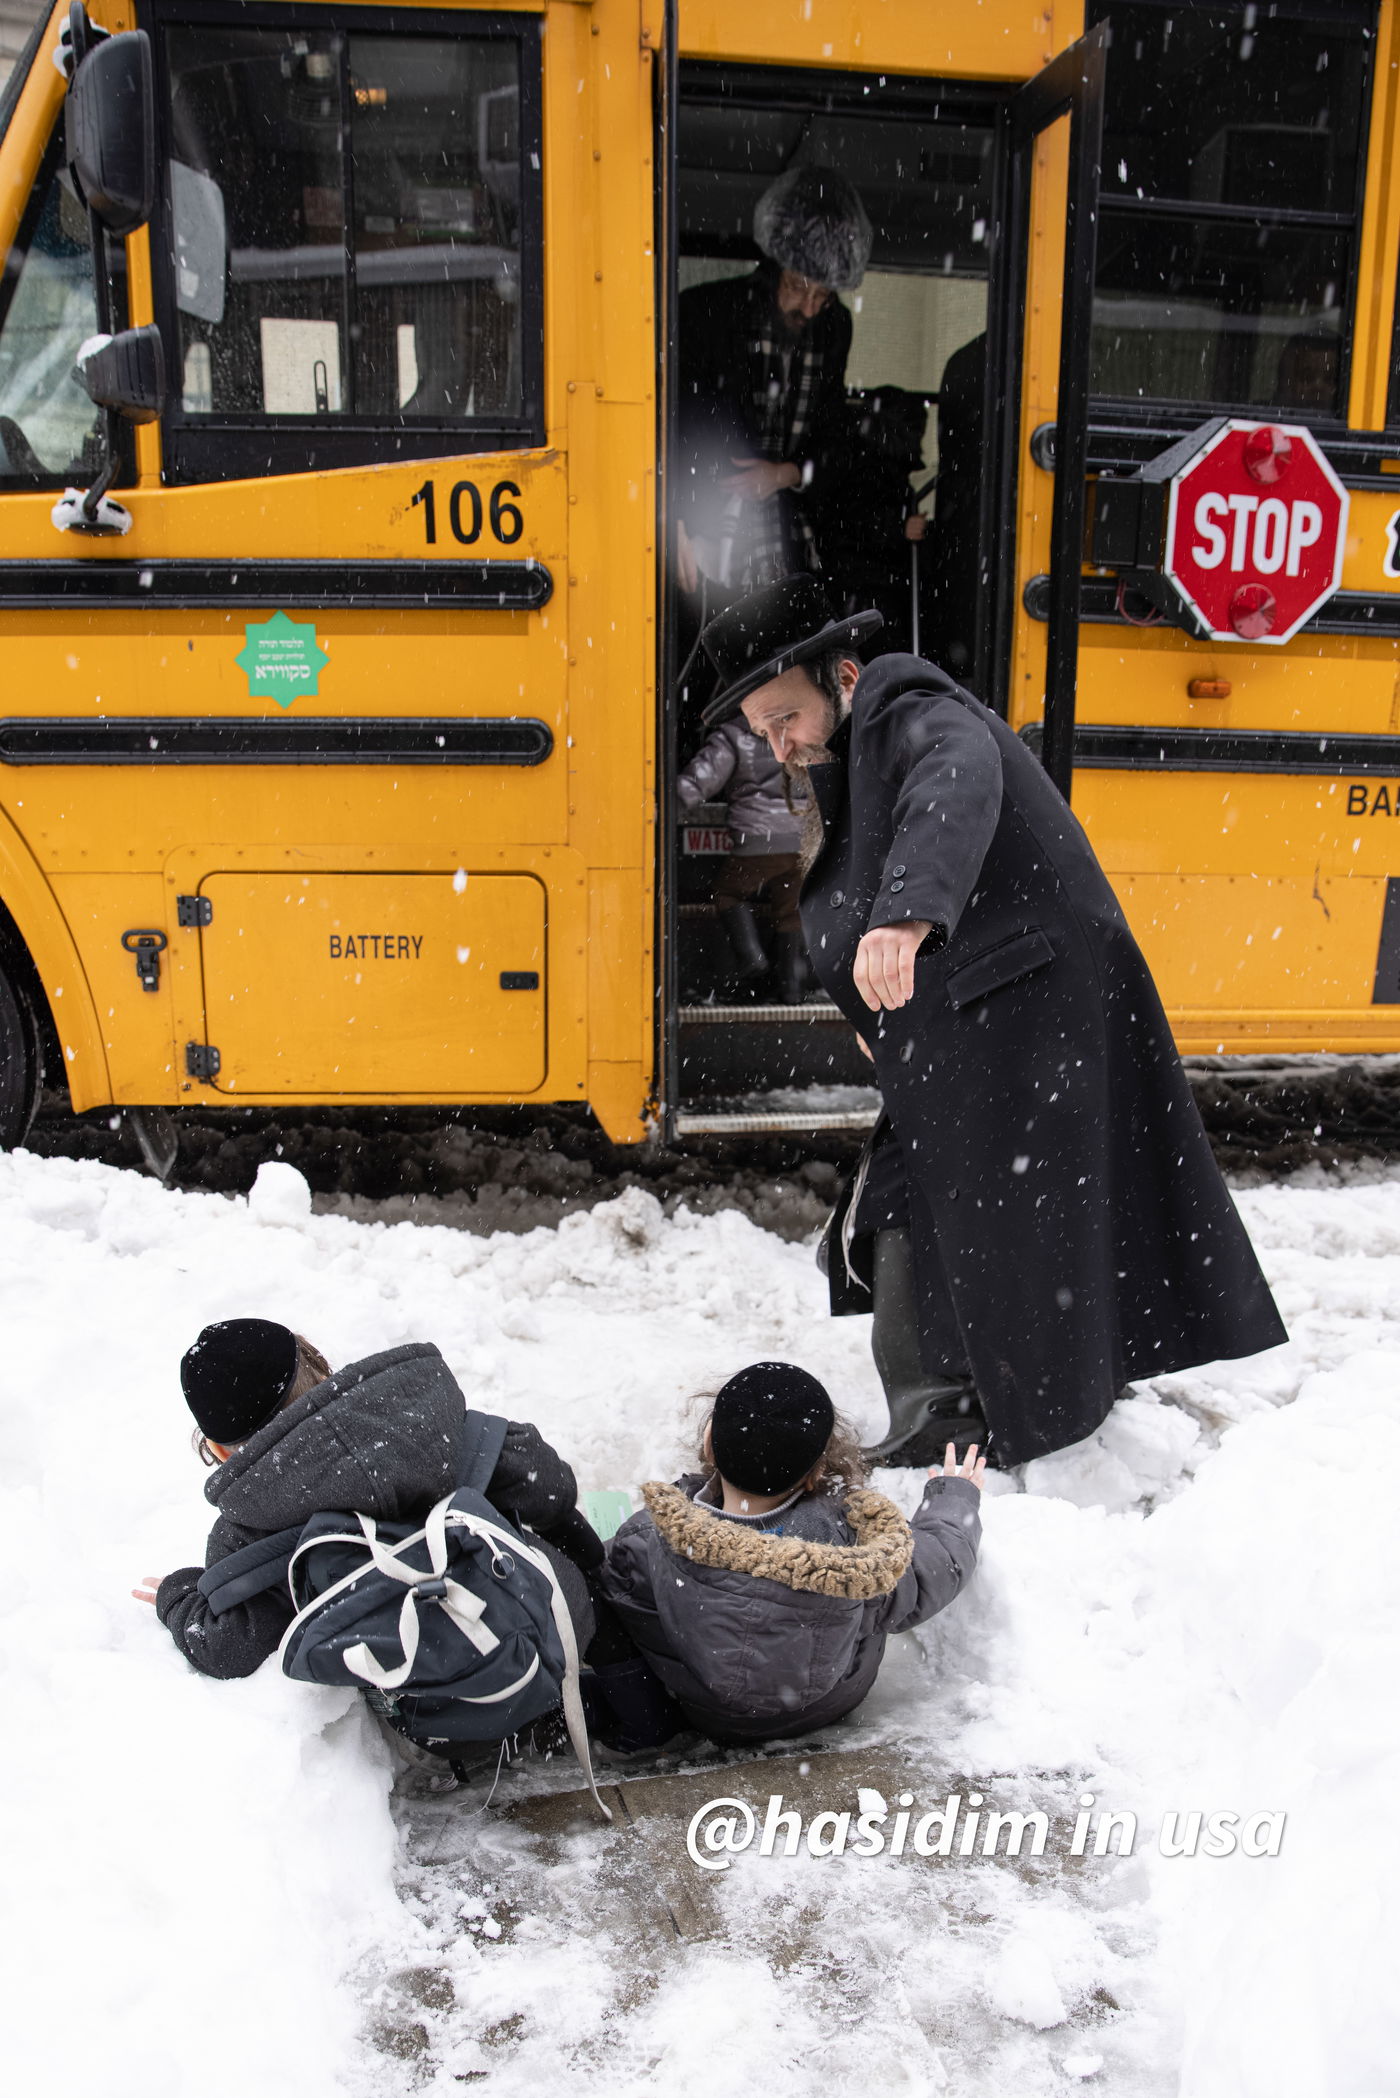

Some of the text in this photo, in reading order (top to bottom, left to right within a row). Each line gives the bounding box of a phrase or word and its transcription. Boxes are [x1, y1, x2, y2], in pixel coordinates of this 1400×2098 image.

[411, 480, 523, 544] 106
[1192, 492, 1322, 577] STOP
[255, 665, 311, 682] סקווירא
[330, 935, 423, 960] BATTERY
